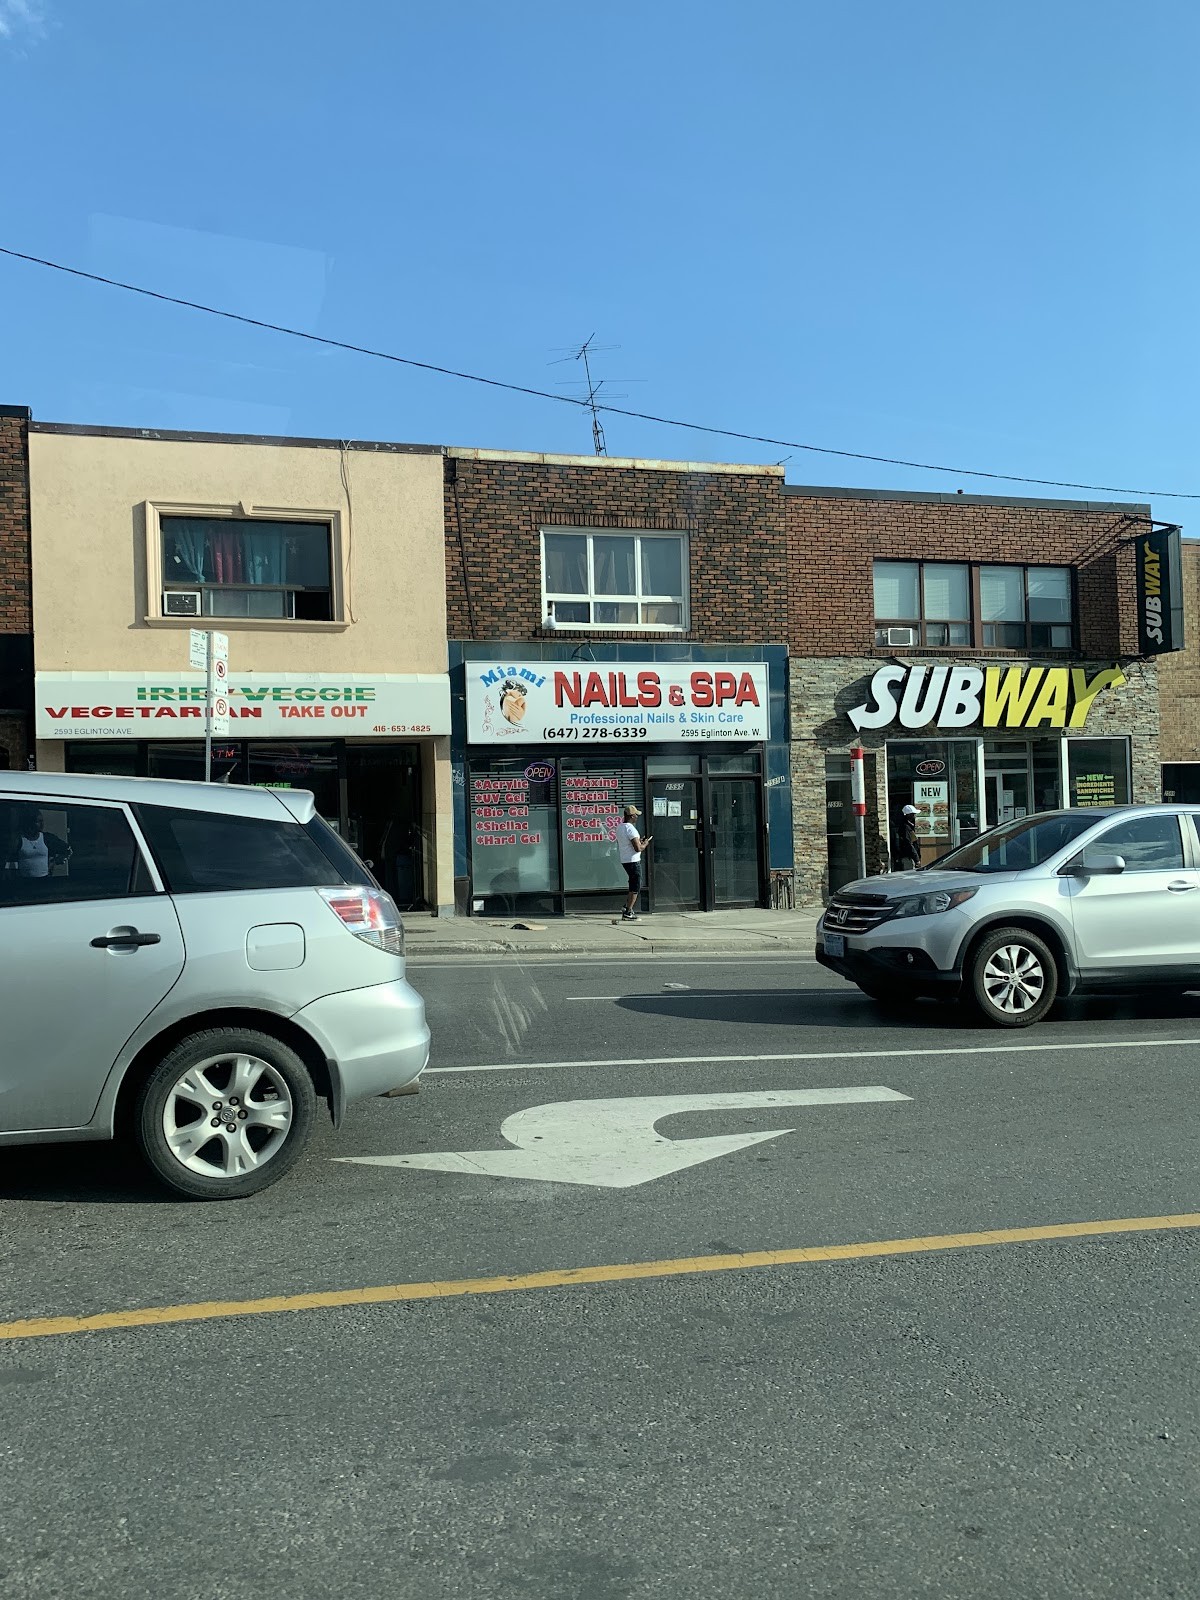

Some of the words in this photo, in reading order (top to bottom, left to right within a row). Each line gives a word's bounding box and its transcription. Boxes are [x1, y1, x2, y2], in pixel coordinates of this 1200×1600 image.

[1143, 541, 1164, 645] SUBWAY
[479, 666, 547, 688] Miami
[137, 687, 208, 701] IRIE
[240, 687, 376, 701] VEGGIE
[554, 671, 662, 708] NAILS
[668, 685, 686, 706] &
[690, 671, 760, 707] SPA
[847, 664, 1127, 732] SUBWAY
[278, 705, 325, 718] TAKE
[330, 705, 368, 718] OUT
[570, 713, 643, 725] Professional
[647, 712, 675, 724] Nails
[678, 712, 687, 723] &
[690, 712, 715, 723] Skin
[718, 712, 744, 723] Care
[543, 728, 579, 740] (647)
[582, 727, 647, 739] 278-6339
[681, 729, 699, 738] 2595
[701, 728, 732, 739] Eglinton
[733, 728, 750, 737] Ave.
[752, 728, 762, 736] W.
[526, 767, 552, 778] OPEN
[919, 763, 942, 772] OPEN
[1086, 773, 1104, 781] NEW
[505, 792, 526, 803] Gel
[920, 787, 941, 798] NEW
[508, 806, 529, 817] Gel
[520, 833, 541, 845] Gel
